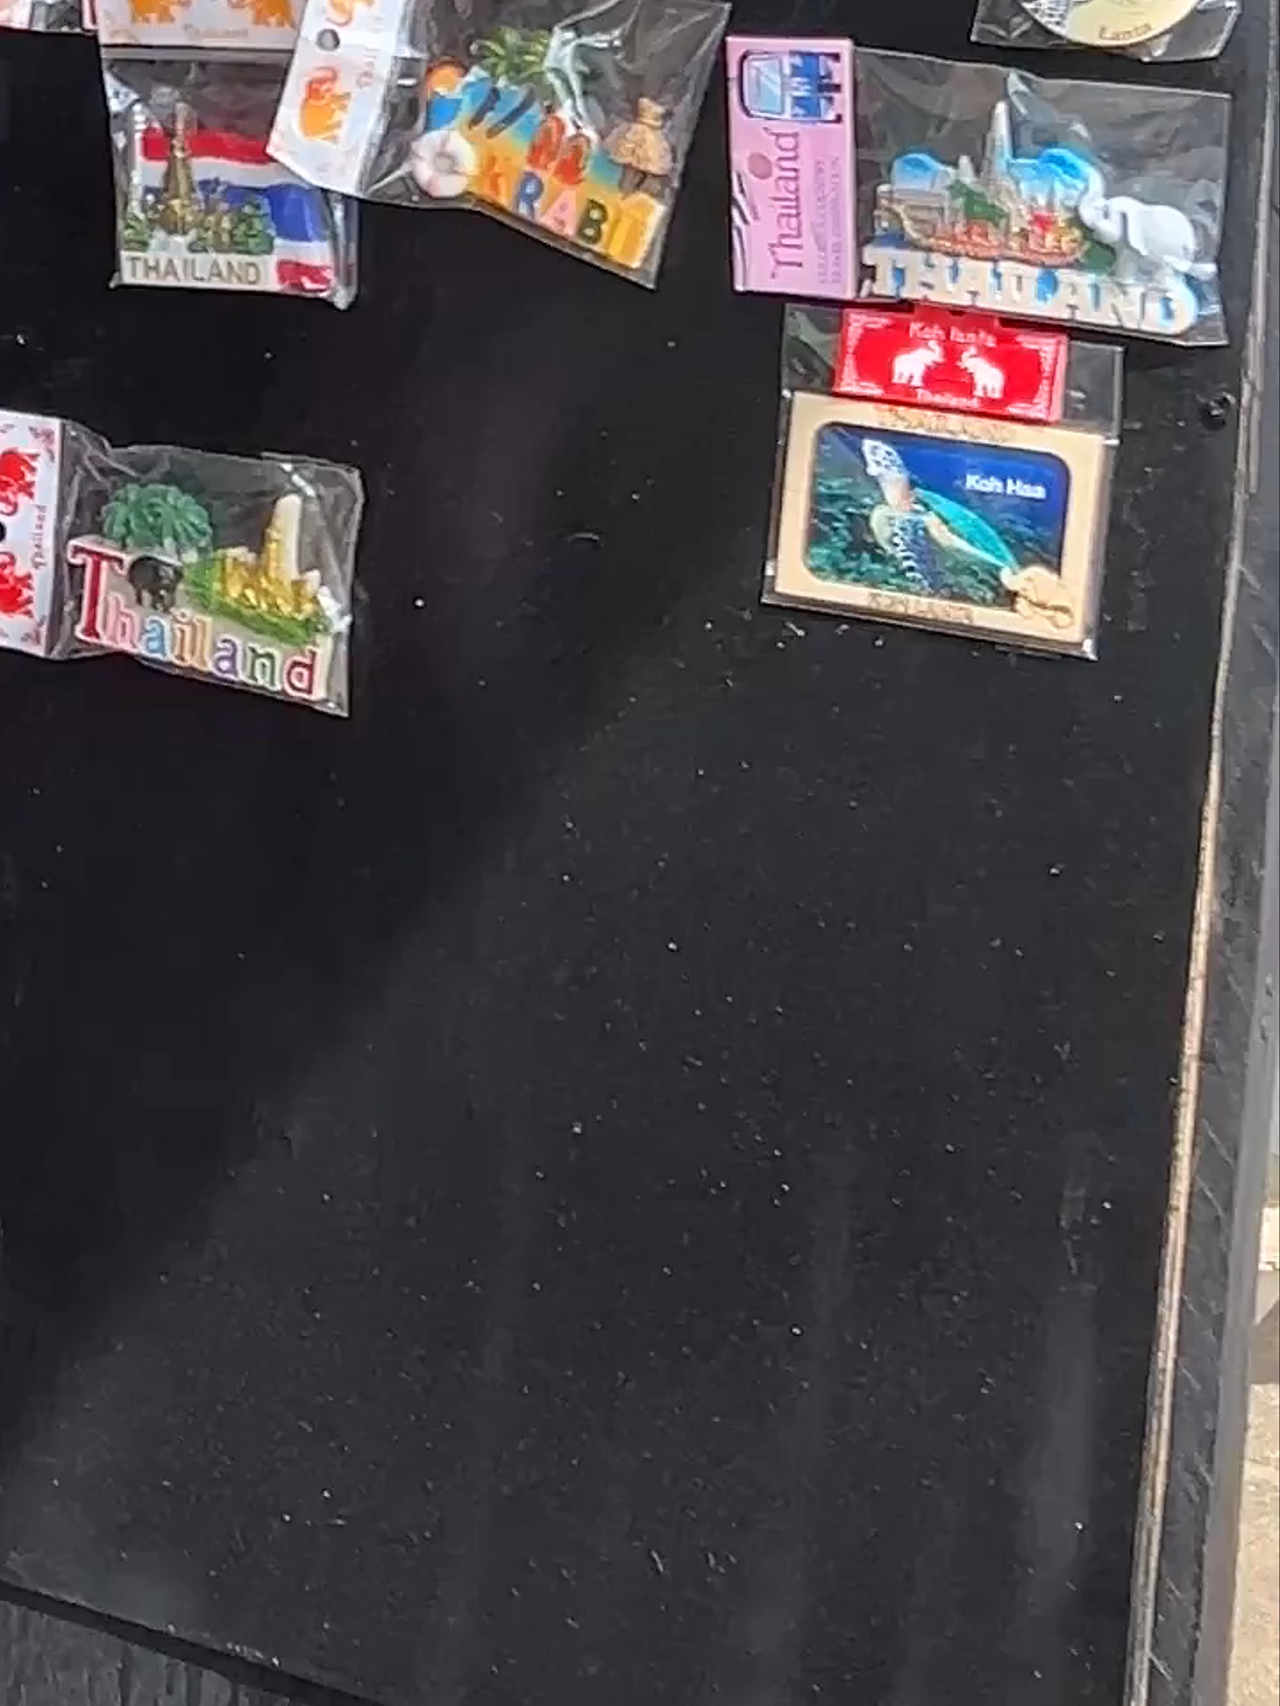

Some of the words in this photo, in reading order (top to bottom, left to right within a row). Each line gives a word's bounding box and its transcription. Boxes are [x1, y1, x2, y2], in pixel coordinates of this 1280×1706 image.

[770, 127, 803, 280] Thailand
[123, 255, 262, 285] THAILAND
[966, 474, 1003, 495] Koh
[67, 535, 327, 700] Thailand
